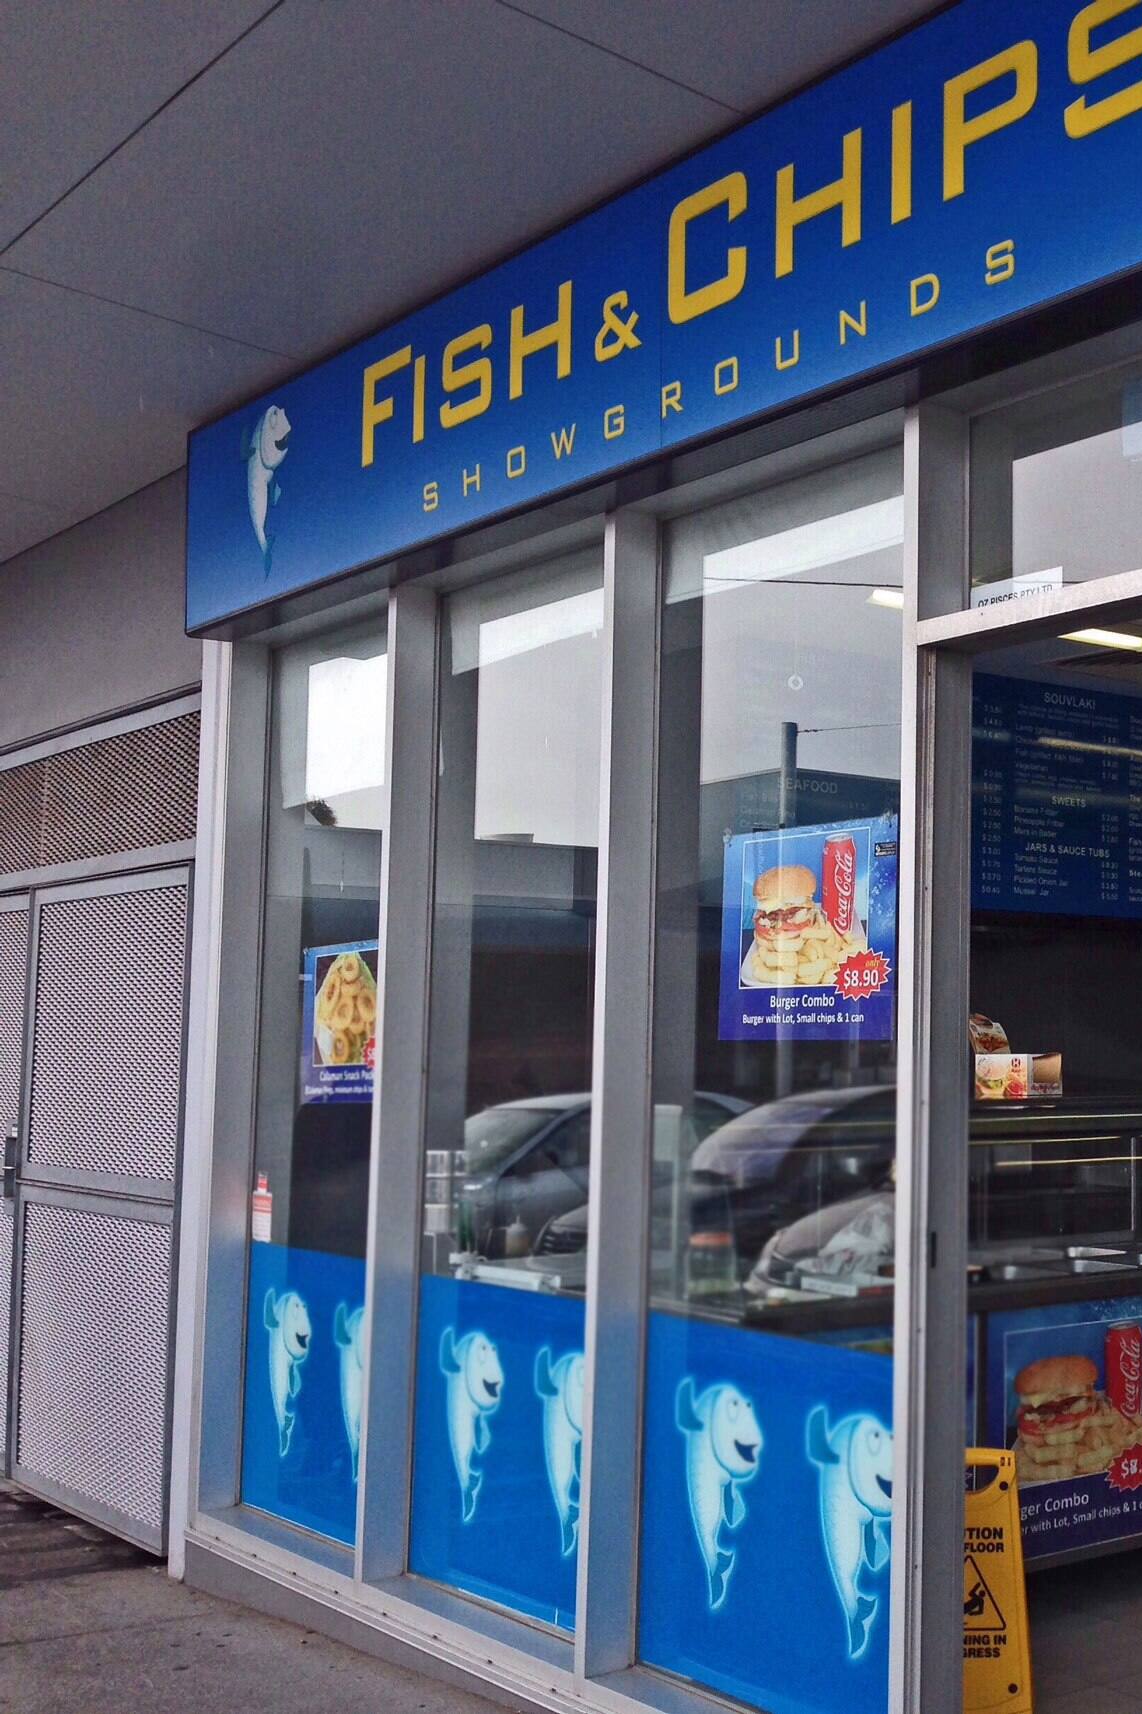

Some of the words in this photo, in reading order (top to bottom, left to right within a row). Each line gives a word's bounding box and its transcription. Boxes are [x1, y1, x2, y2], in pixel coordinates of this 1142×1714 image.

[361, 279, 572, 469] FISH
[594, 290, 642, 363] &
[422, 238, 1016, 513] SHOWGROUNDS
[1044, 692, 1096, 710] SOUVLAKI
[778, 777, 838, 794] SEAFOOD
[1052, 795, 1087, 808] SWEETS
[1025, 842, 1048, 854] JARS
[1049, 844, 1056, 854] &
[1058, 845, 1087, 857] SAUCE
[1089, 848, 1110, 859] TUBS
[843, 969, 880, 989] $8.90
[770, 995, 800, 1010] Burger
[801, 993, 835, 1008] Combo
[742, 1014, 764, 1026] Burger
[765, 1013, 780, 1024] with
[782, 1013, 795, 1025] Lot,
[797, 1012, 815, 1023] Small
[817, 1012, 835, 1025] chips
[837, 1013, 843, 1023] &
[845, 1013, 849, 1023] 1
[851, 1014, 864, 1023] can
[1020, 1502, 1041, 1521] ger
[1044, 1492, 1090, 1513] Combo
[1030, 1520, 1052, 1533] with
[1053, 1516, 1071, 1529] Lot,
[1073, 1510, 1097, 1524] Small
[1098, 1505, 1121, 1519] chips
[1122, 1502, 1130, 1513] &
[1132, 1501, 1137, 1511] 1
[963, 1526, 1004, 1540] TION
[964, 1541, 1005, 1553] FLOOR
[993, 1634, 1007, 1646] IN
